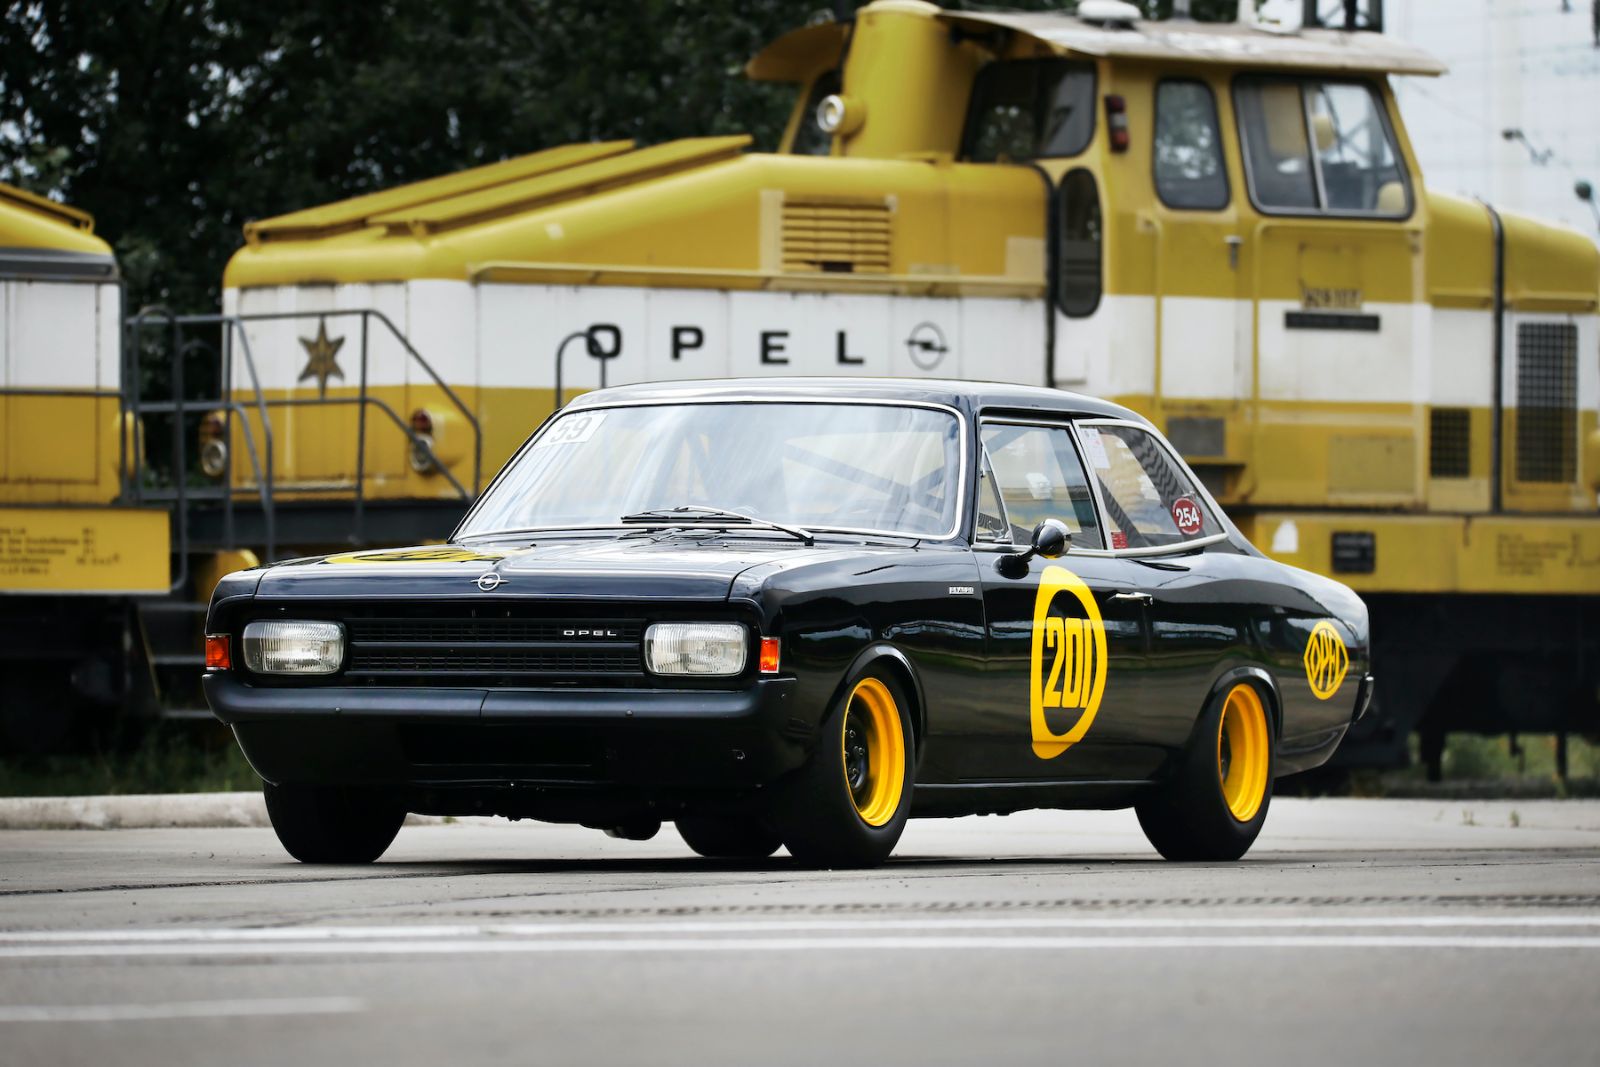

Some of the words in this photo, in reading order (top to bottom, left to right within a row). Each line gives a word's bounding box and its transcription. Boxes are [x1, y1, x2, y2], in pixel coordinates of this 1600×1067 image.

[585, 323, 865, 366] OPEL
[1175, 506, 1200, 528] 254
[562, 629, 617, 637] OPEL
[1042, 616, 1093, 709] 201
